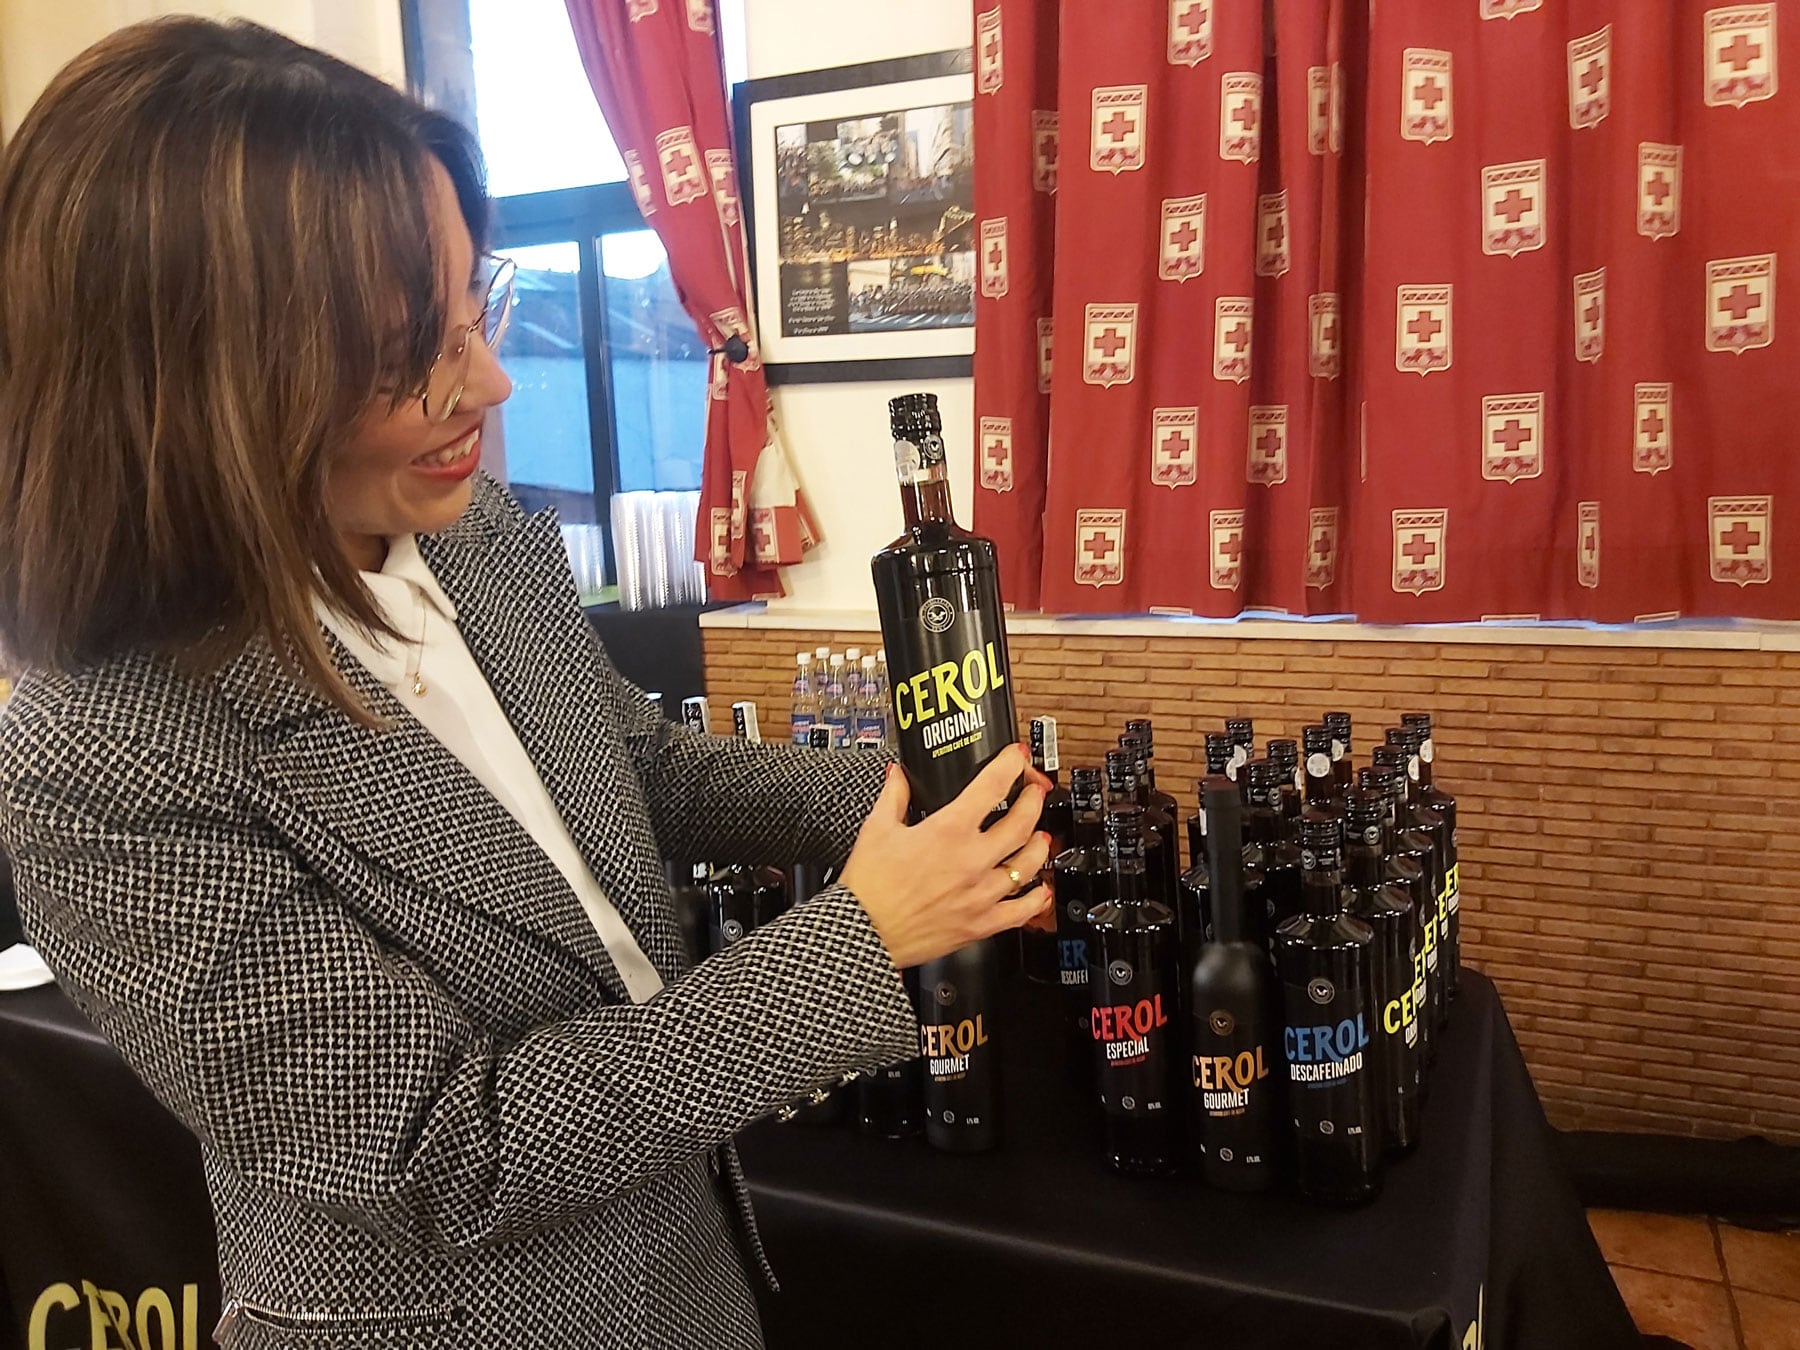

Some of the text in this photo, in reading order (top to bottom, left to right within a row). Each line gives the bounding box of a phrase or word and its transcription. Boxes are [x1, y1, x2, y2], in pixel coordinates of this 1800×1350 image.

[896, 643, 1004, 729] CEROL
[923, 704, 986, 749] ORIGINAL
[921, 1013, 988, 1058] CEROL
[1091, 993, 1168, 1042] CEROL
[1284, 1011, 1370, 1063] CEROL
[930, 1053, 970, 1076] GOURMET
[1106, 1036, 1150, 1060] ESPECIAL
[1192, 1045, 1269, 1093] CEROL
[1290, 1051, 1363, 1082] DESCAFEINADO
[1203, 1087, 1249, 1110] GOURMET
